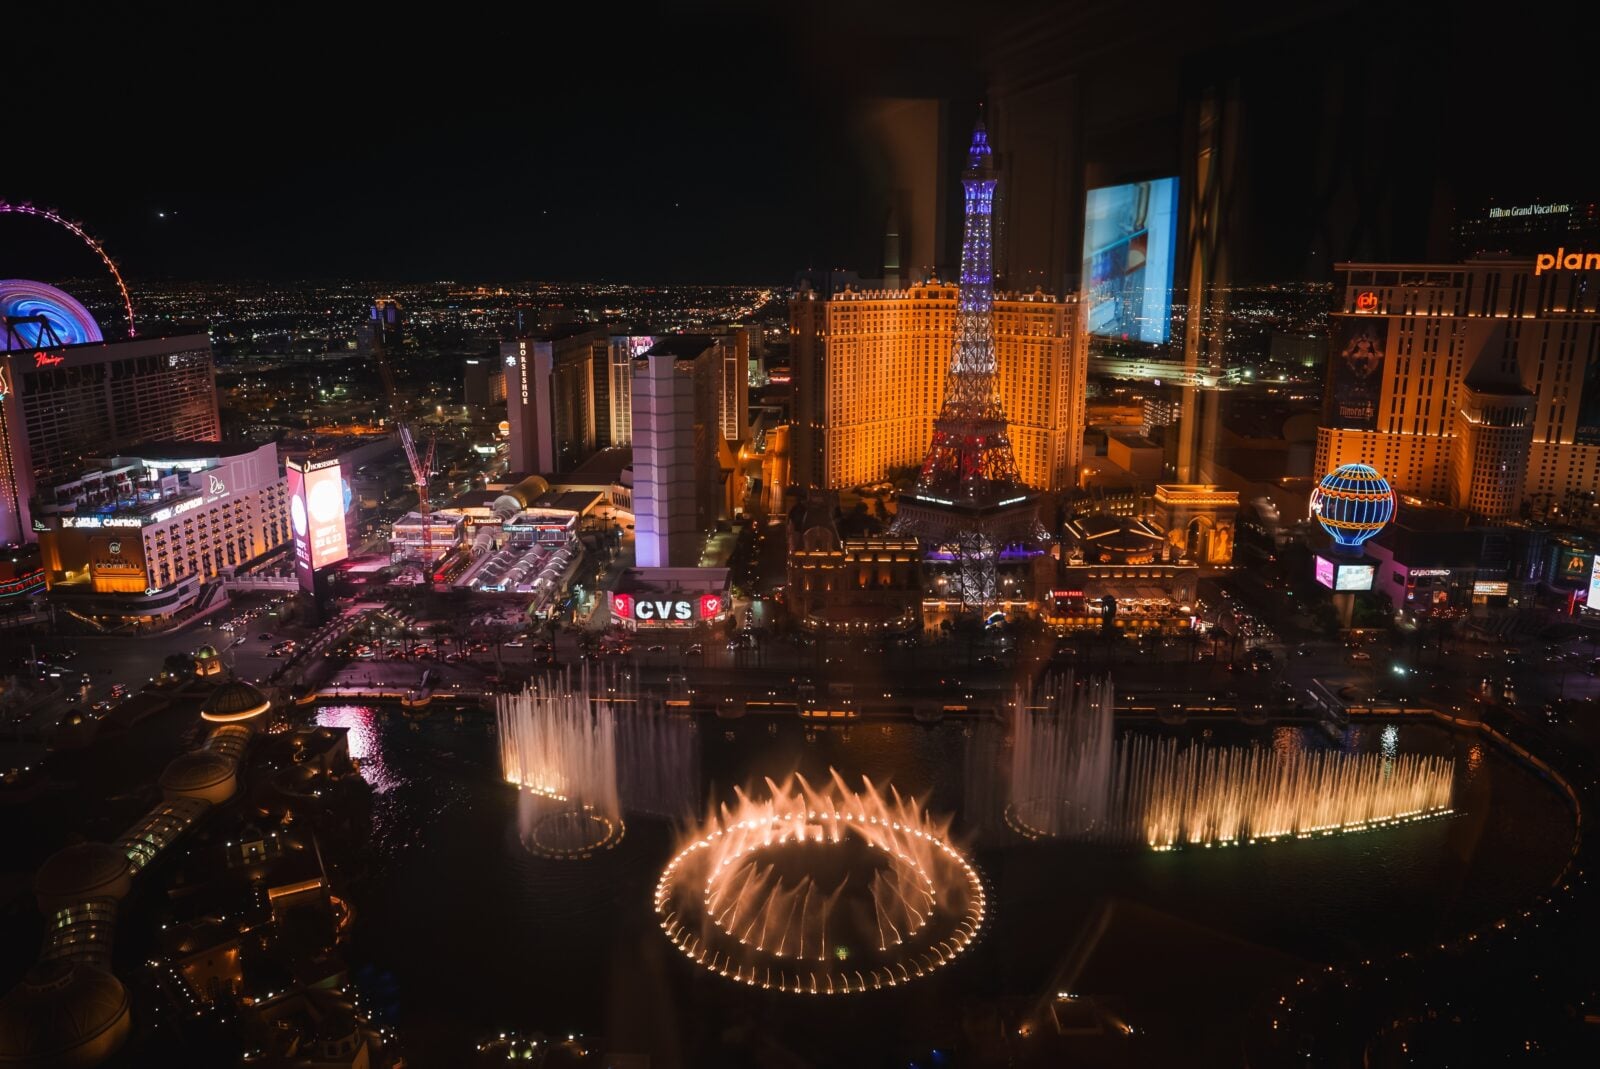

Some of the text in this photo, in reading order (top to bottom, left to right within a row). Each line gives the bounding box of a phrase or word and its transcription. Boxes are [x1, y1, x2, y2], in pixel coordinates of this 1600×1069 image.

[1490, 203, 1570, 218] Hilton Grand Vacations
[1535, 247, 1600, 276] plan
[1360, 292, 1378, 308] ph
[520, 342, 528, 405] HORSESHOE
[635, 601, 692, 619] CVS
